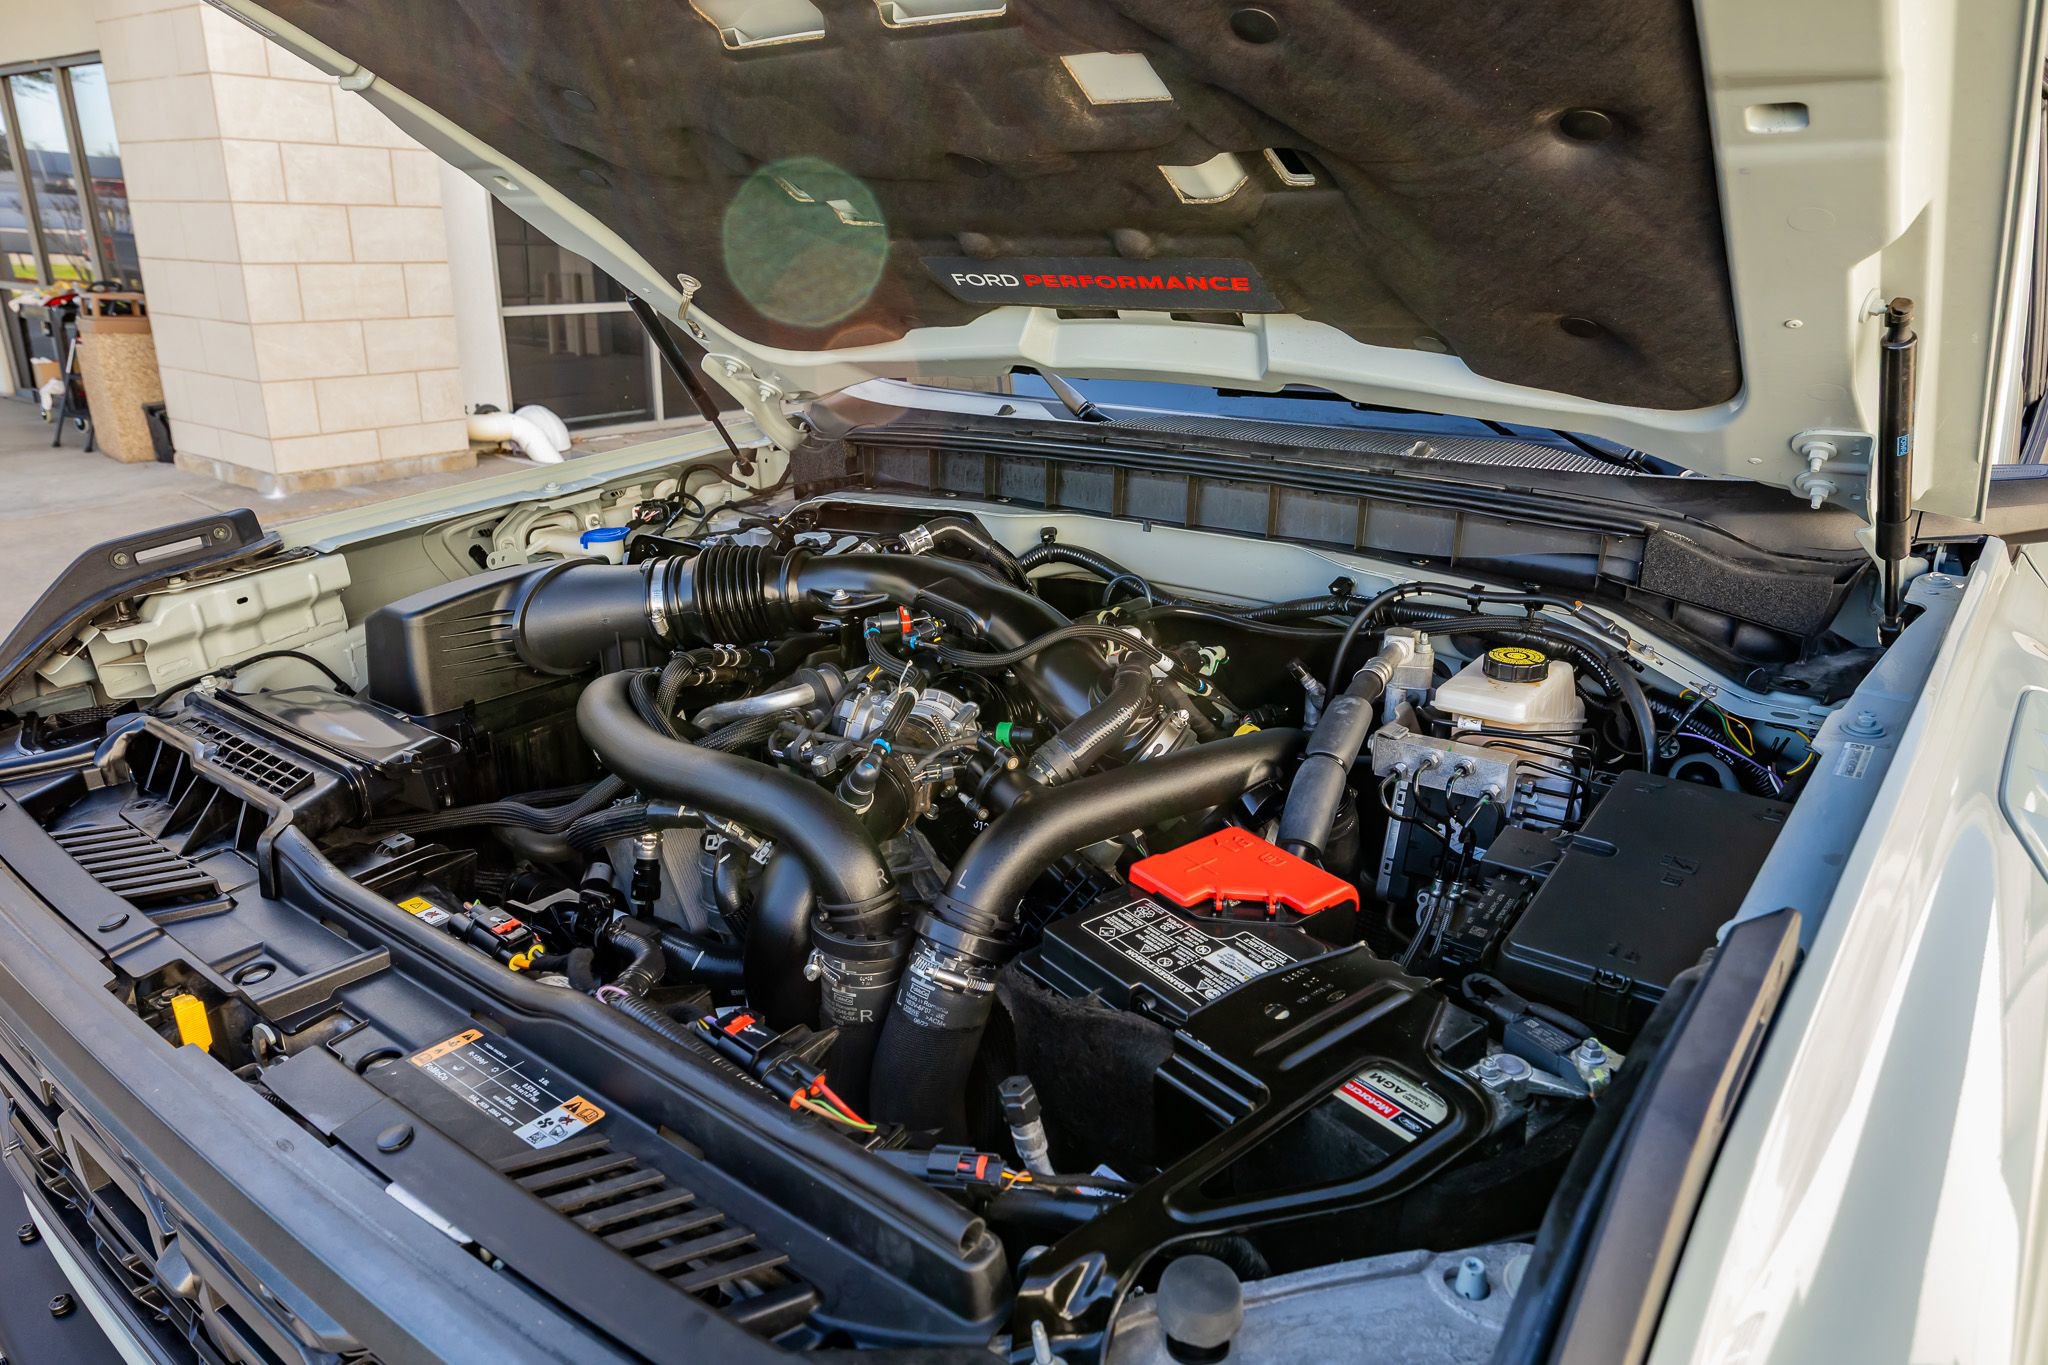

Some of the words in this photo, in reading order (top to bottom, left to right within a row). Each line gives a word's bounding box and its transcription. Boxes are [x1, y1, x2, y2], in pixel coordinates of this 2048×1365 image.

[951, 273, 1019, 287] FORD
[1023, 274, 1251, 291] PERFORMANCE
[877, 868, 889, 888] R
[957, 869, 968, 889] L
[1125, 949, 1186, 989] DANGER/POISON
[860, 1009, 874, 1023] R
[423, 1063, 451, 1081] FoMoCo
[1370, 1073, 1406, 1094] AGM
[504, 1096, 519, 1105] PAG
